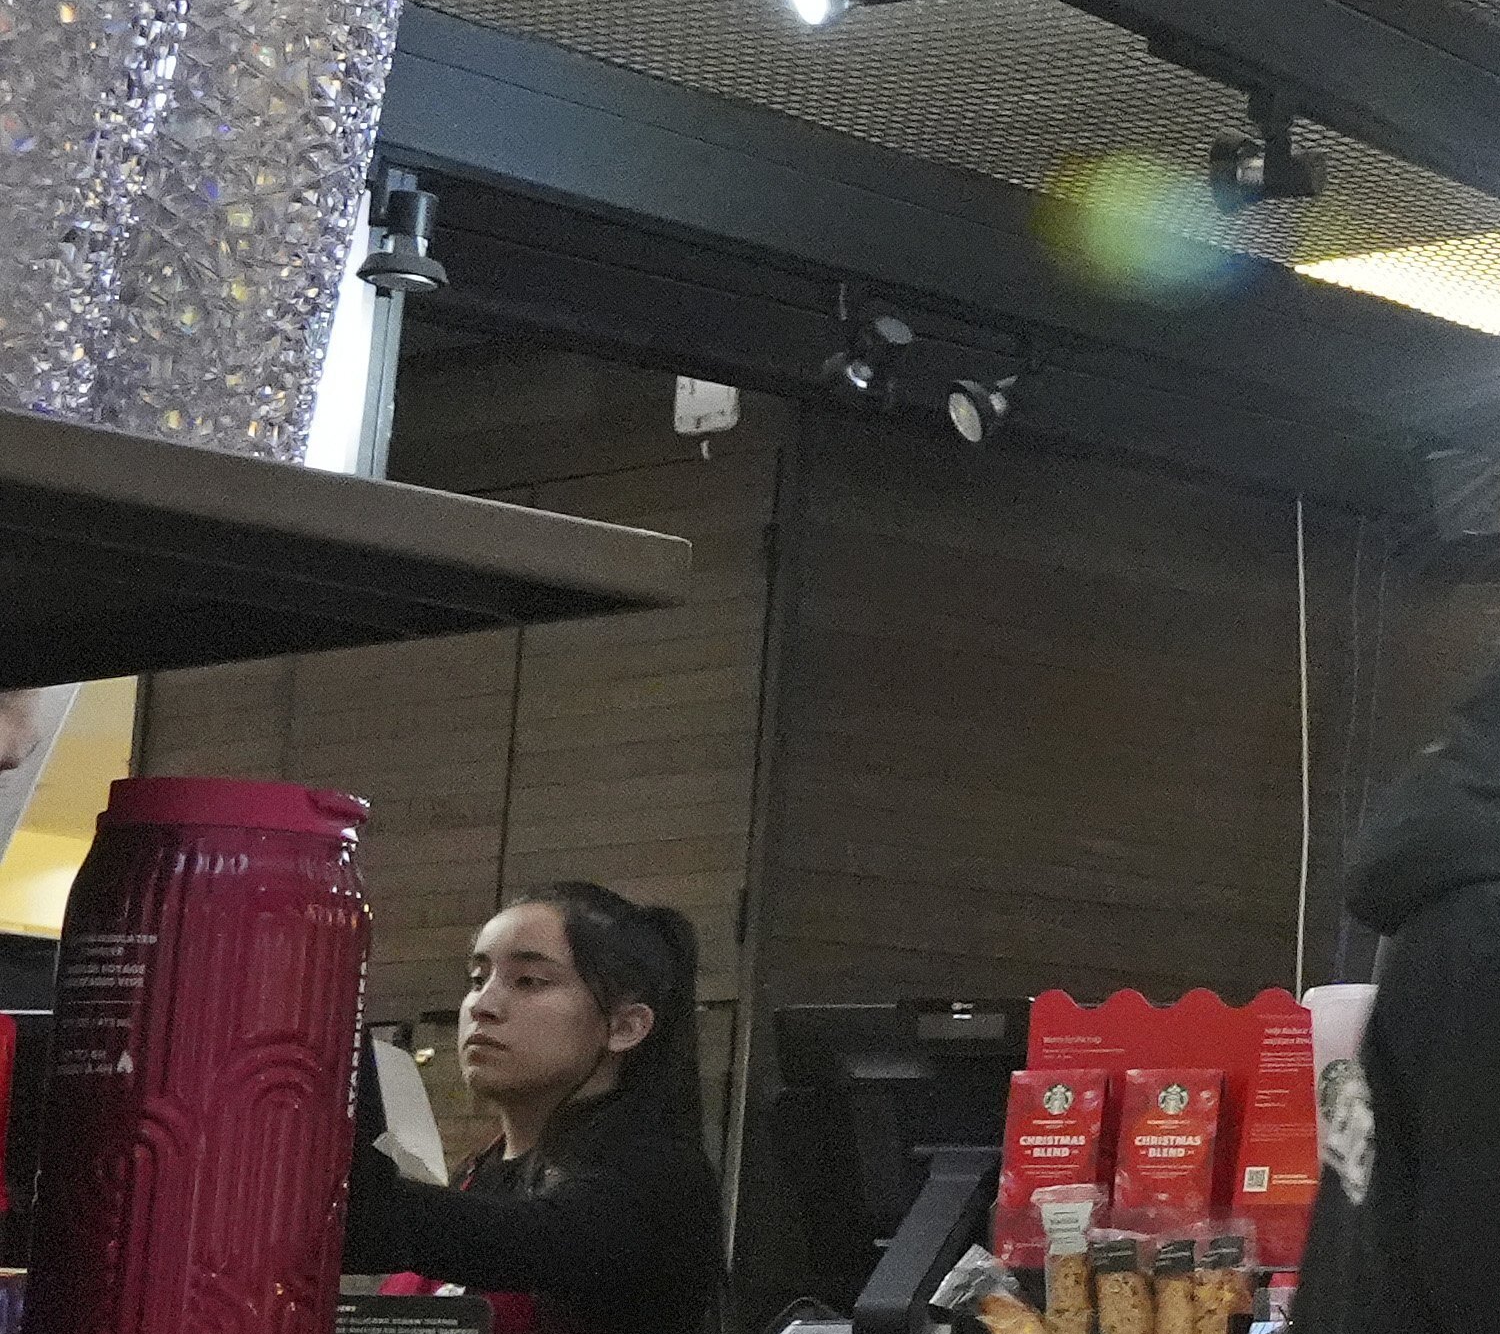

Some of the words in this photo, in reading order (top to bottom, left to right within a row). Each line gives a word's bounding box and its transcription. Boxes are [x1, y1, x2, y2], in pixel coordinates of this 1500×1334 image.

[1019, 1135, 1086, 1145] CHRISTMAS
[1134, 1135, 1201, 1146] CHRISTMAS
[1032, 1148, 1070, 1158] BLEND
[1147, 1148, 1185, 1158] BLEND
